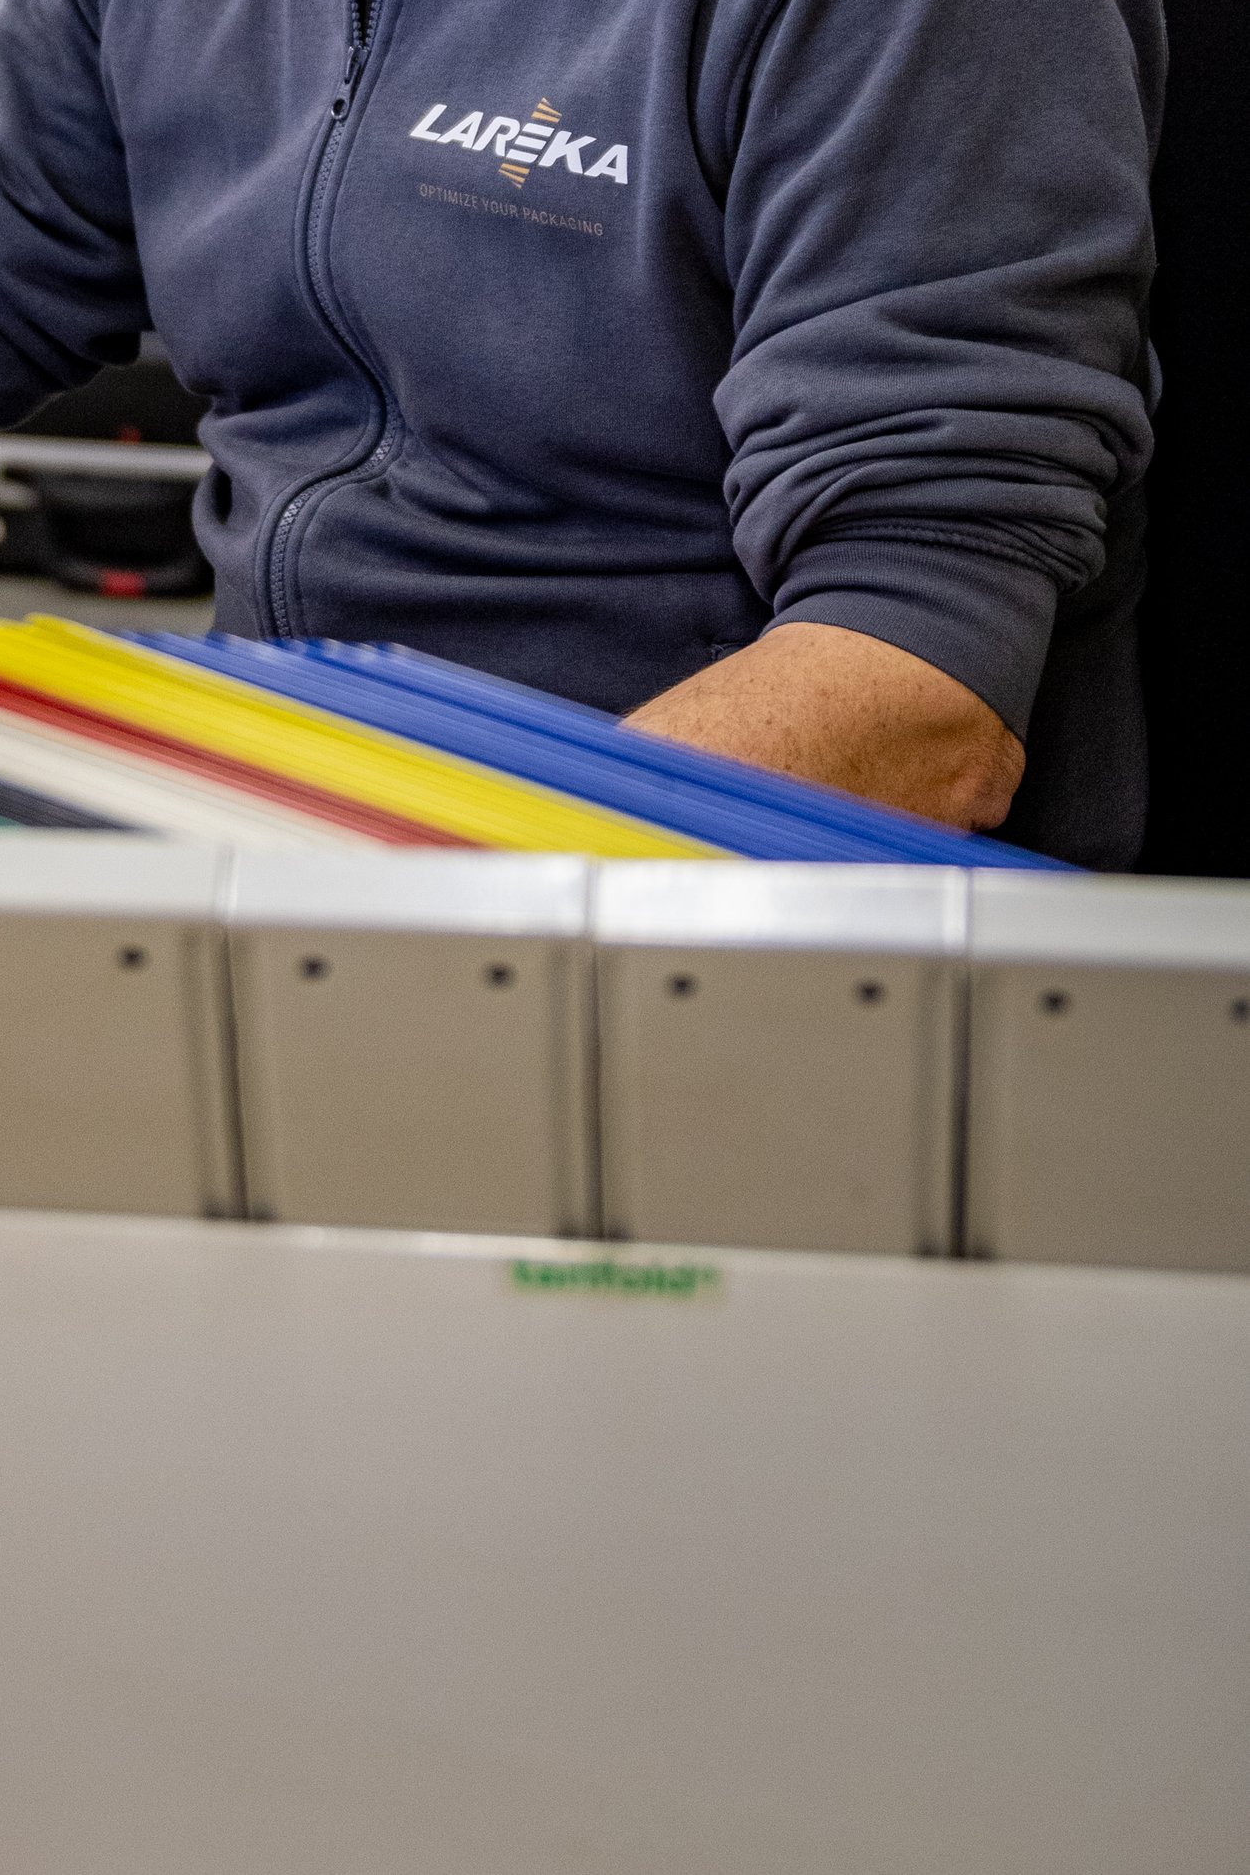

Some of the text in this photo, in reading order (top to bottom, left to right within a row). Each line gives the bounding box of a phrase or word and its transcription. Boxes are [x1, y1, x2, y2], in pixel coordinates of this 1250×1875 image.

[410, 103, 629, 185] LAREKA
[418, 183, 605, 237] OPTIMIZE YOUR PACKAGING
